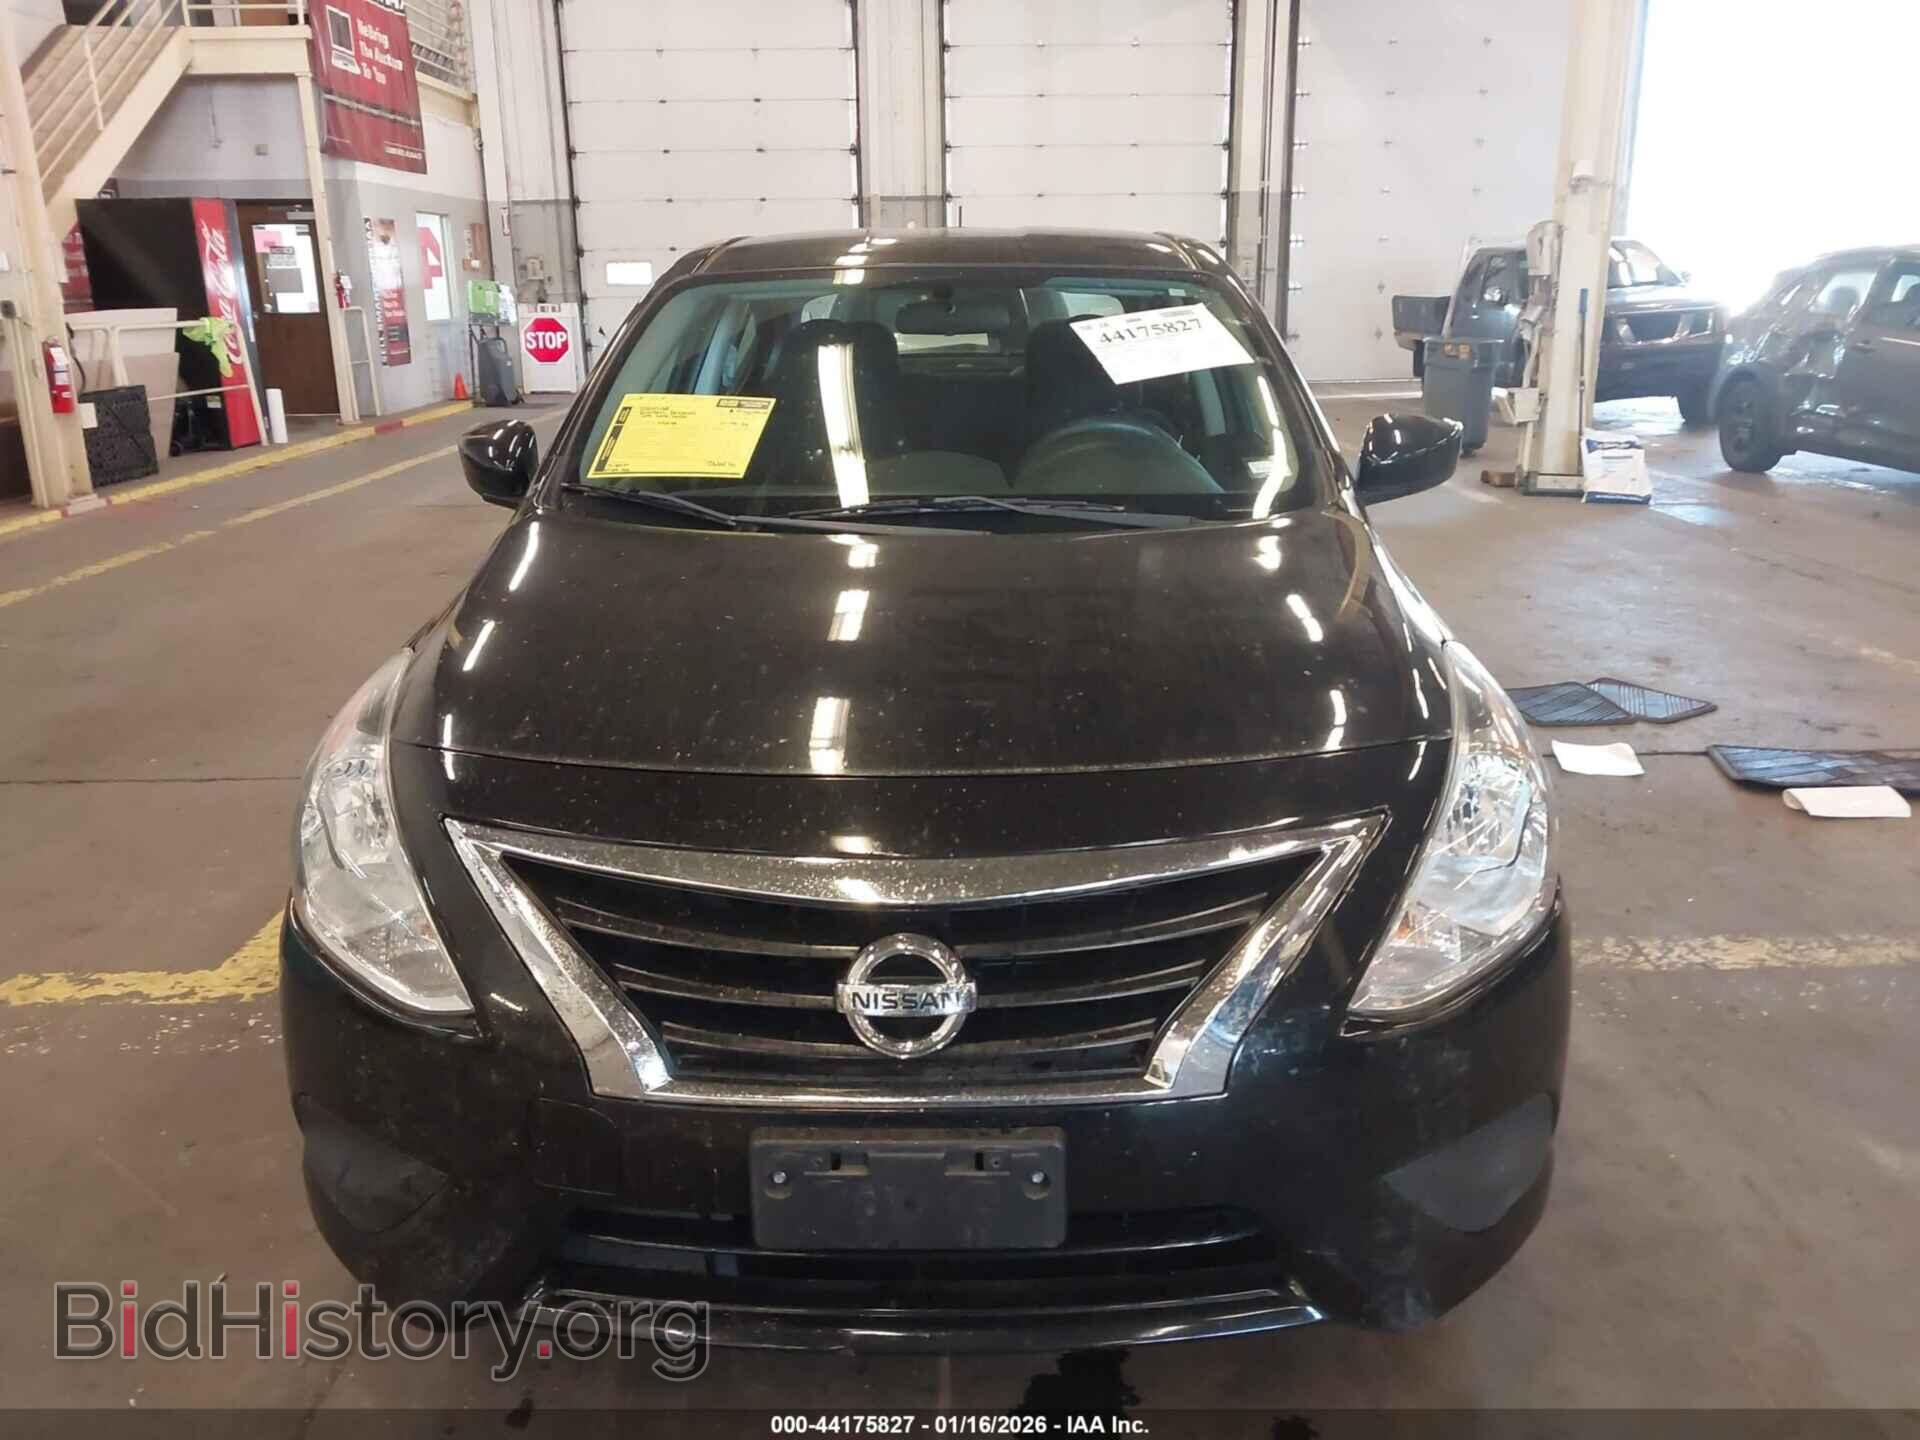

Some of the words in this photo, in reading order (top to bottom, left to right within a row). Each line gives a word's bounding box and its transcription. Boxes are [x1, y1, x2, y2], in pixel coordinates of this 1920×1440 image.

[526, 331, 567, 349] STOP
[1099, 318, 1202, 343] 44175827
[851, 991, 962, 1010] NISSAN
